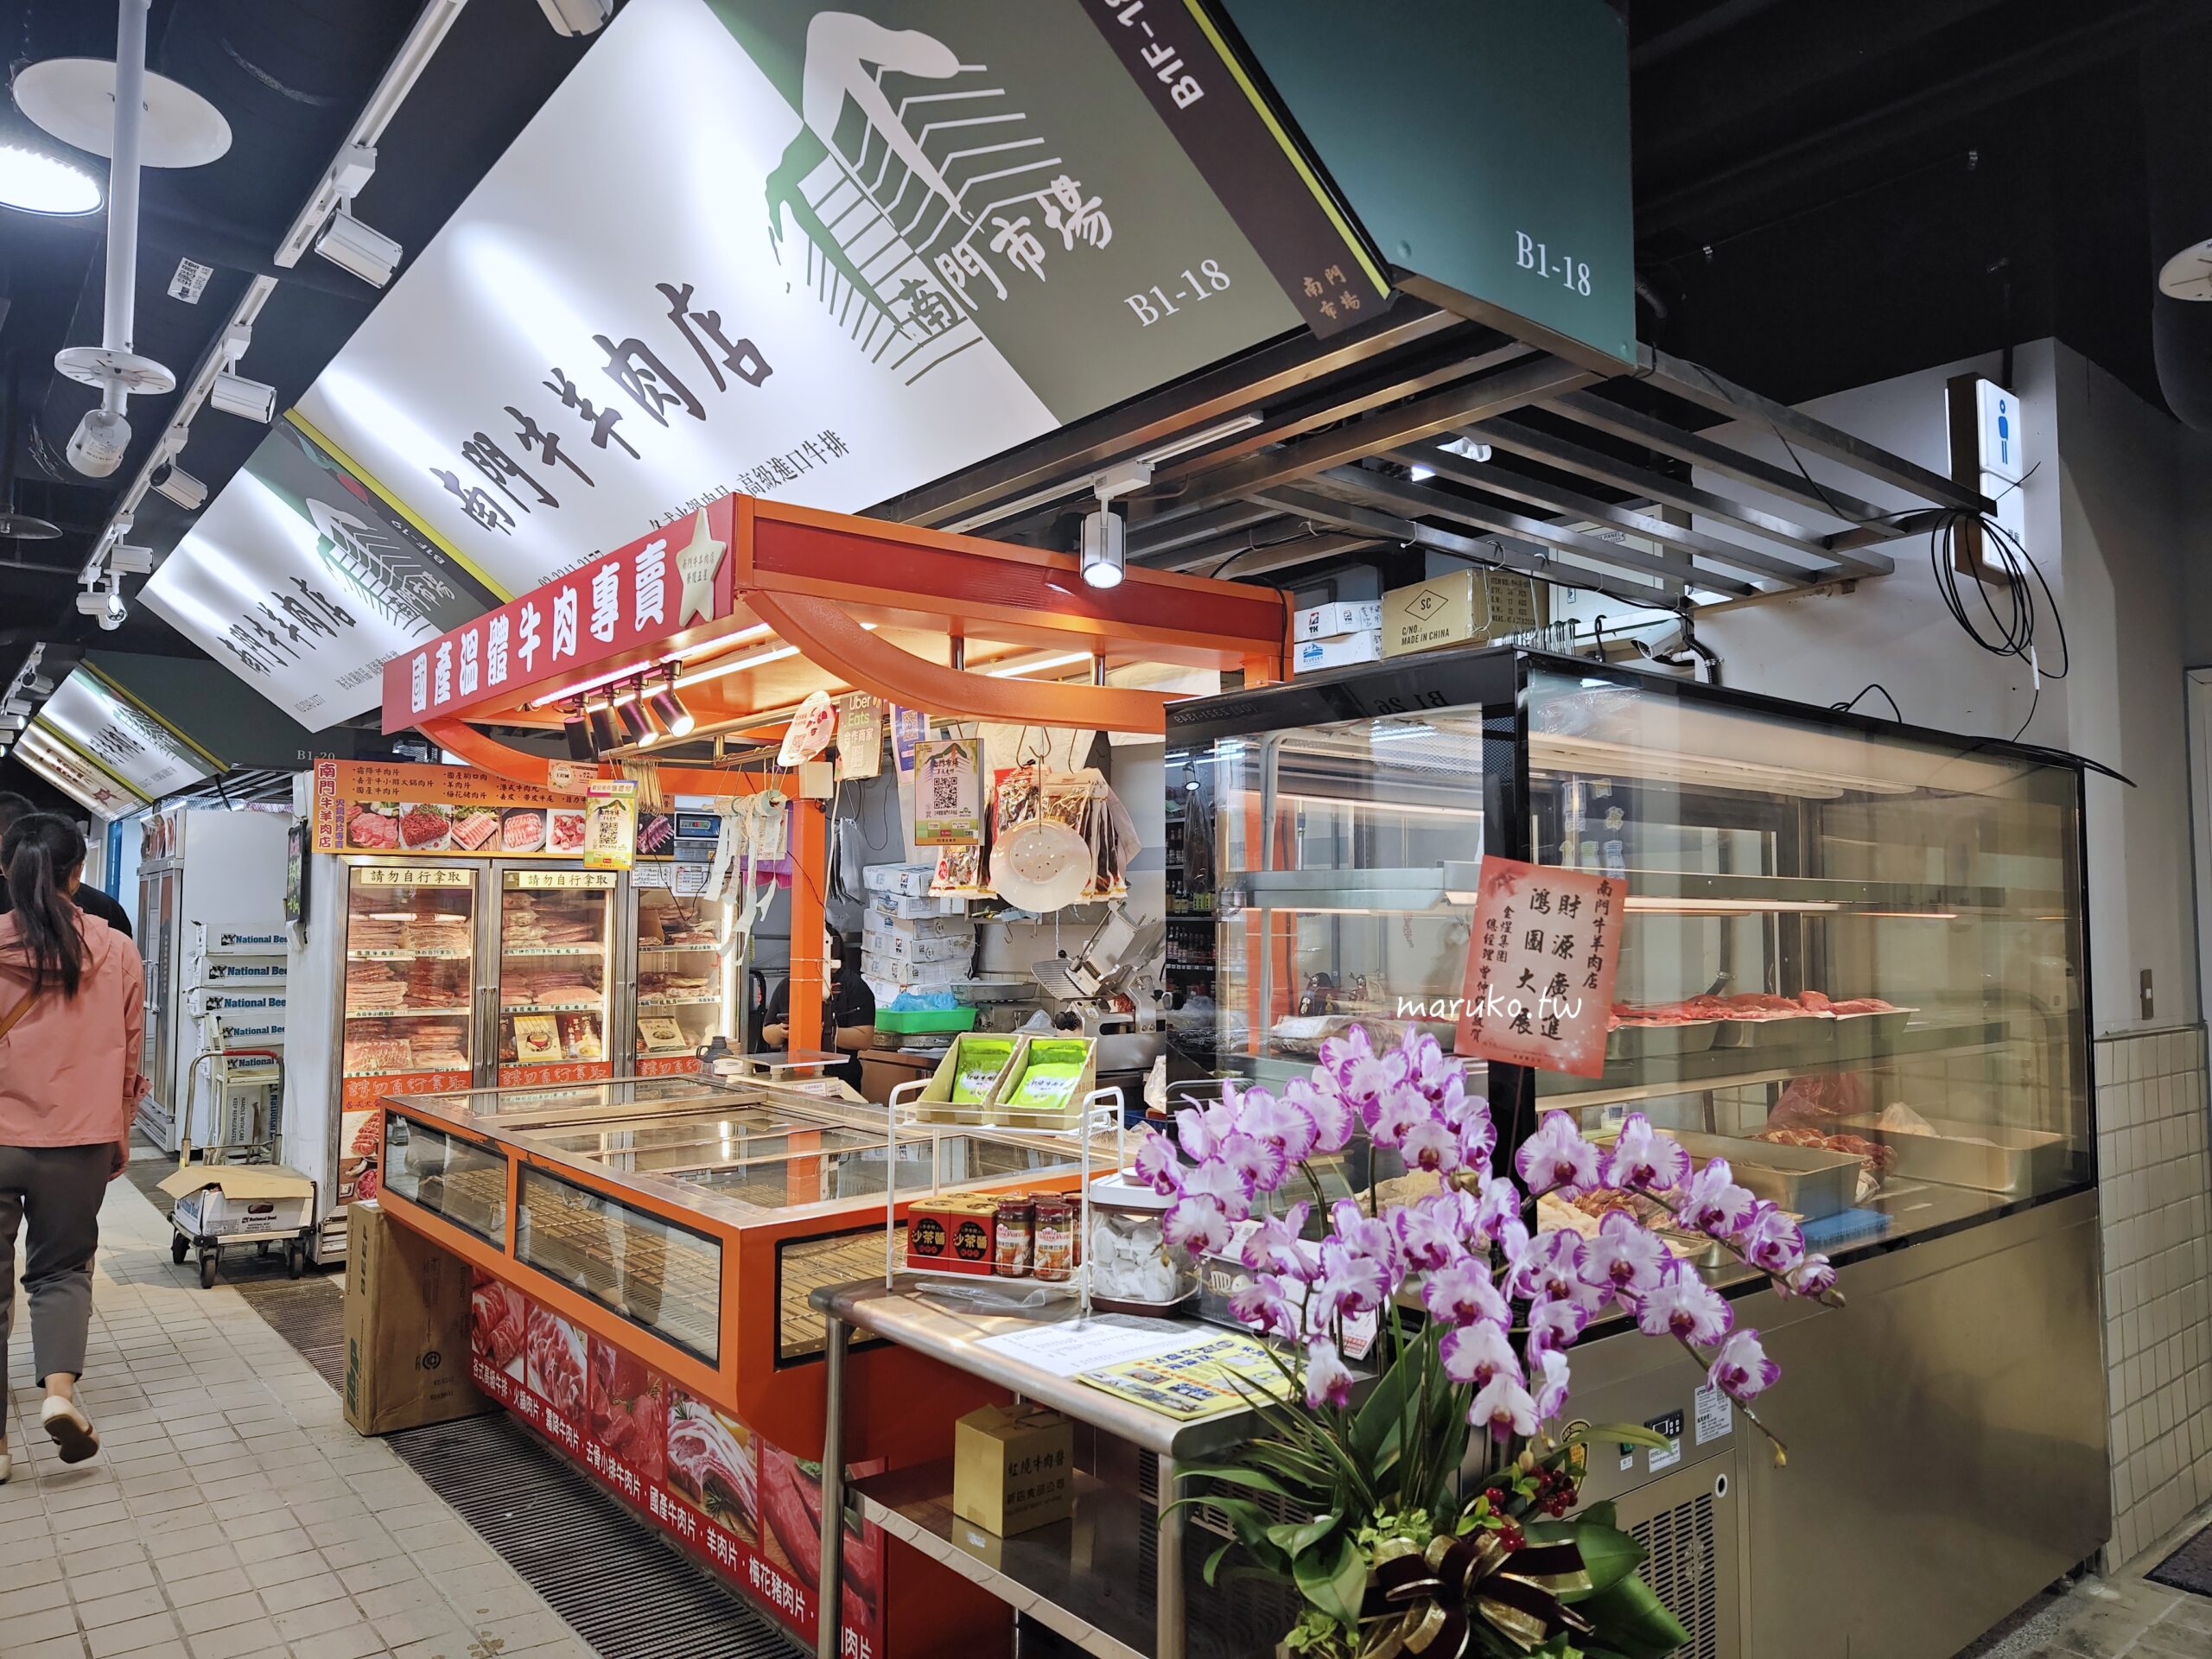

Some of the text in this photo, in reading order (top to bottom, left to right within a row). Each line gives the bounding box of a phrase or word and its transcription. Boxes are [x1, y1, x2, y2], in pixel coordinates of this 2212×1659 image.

[895, 175, 1113, 342] 南門市場
[1516, 230, 1592, 299] B1-18
[1123, 258, 1233, 329] B1-18
[429, 282, 774, 537] 南門牛羊肉店
[391, 519, 446, 566] B1F-19
[1420, 596, 1433, 611] SC
[217, 576, 358, 677] 南門牛羊肉店
[410, 537, 668, 715] 國產溫體牛肉專賣
[1401, 628, 1451, 646] MADE IN CHINA
[849, 696, 871, 710] Uber
[849, 712, 871, 728] Eats
[843, 728, 874, 745] 合作商家
[297, 749, 336, 760] B1-20
[355, 766, 401, 777] 霜降牛肉片
[356, 777, 435, 788] 去骨牛小排火鍋肉片
[446, 780, 472, 790] 羊肉片
[355, 787, 400, 796] 國產牛肉片
[318, 762, 337, 849] 南門牛羊肉店
[369, 869, 462, 884] 請勿自行拿取
[527, 873, 609, 887] 請勿自行拿取
[236, 933, 289, 944] National Bee
[1581, 880, 1614, 990] 南門牛羊肉店
[1509, 887, 1552, 1037] 鴻圖大展
[1541, 893, 1583, 1042] 財源廣進
[227, 965, 268, 977] National
[224, 996, 265, 1009] National
[232, 1025, 270, 1037] National
[238, 1057, 275, 1068] National
[500, 1064, 609, 1086] 請勿自行拿取
[346, 1074, 469, 1098] 請勿自行拿取
[911, 1229, 947, 1246] 沙茶醬
[952, 1232, 989, 1250] 沙茶醬
[747, 1554, 807, 1624] 梅花豬肉片
[841, 1624, 873, 1659] 肉片
